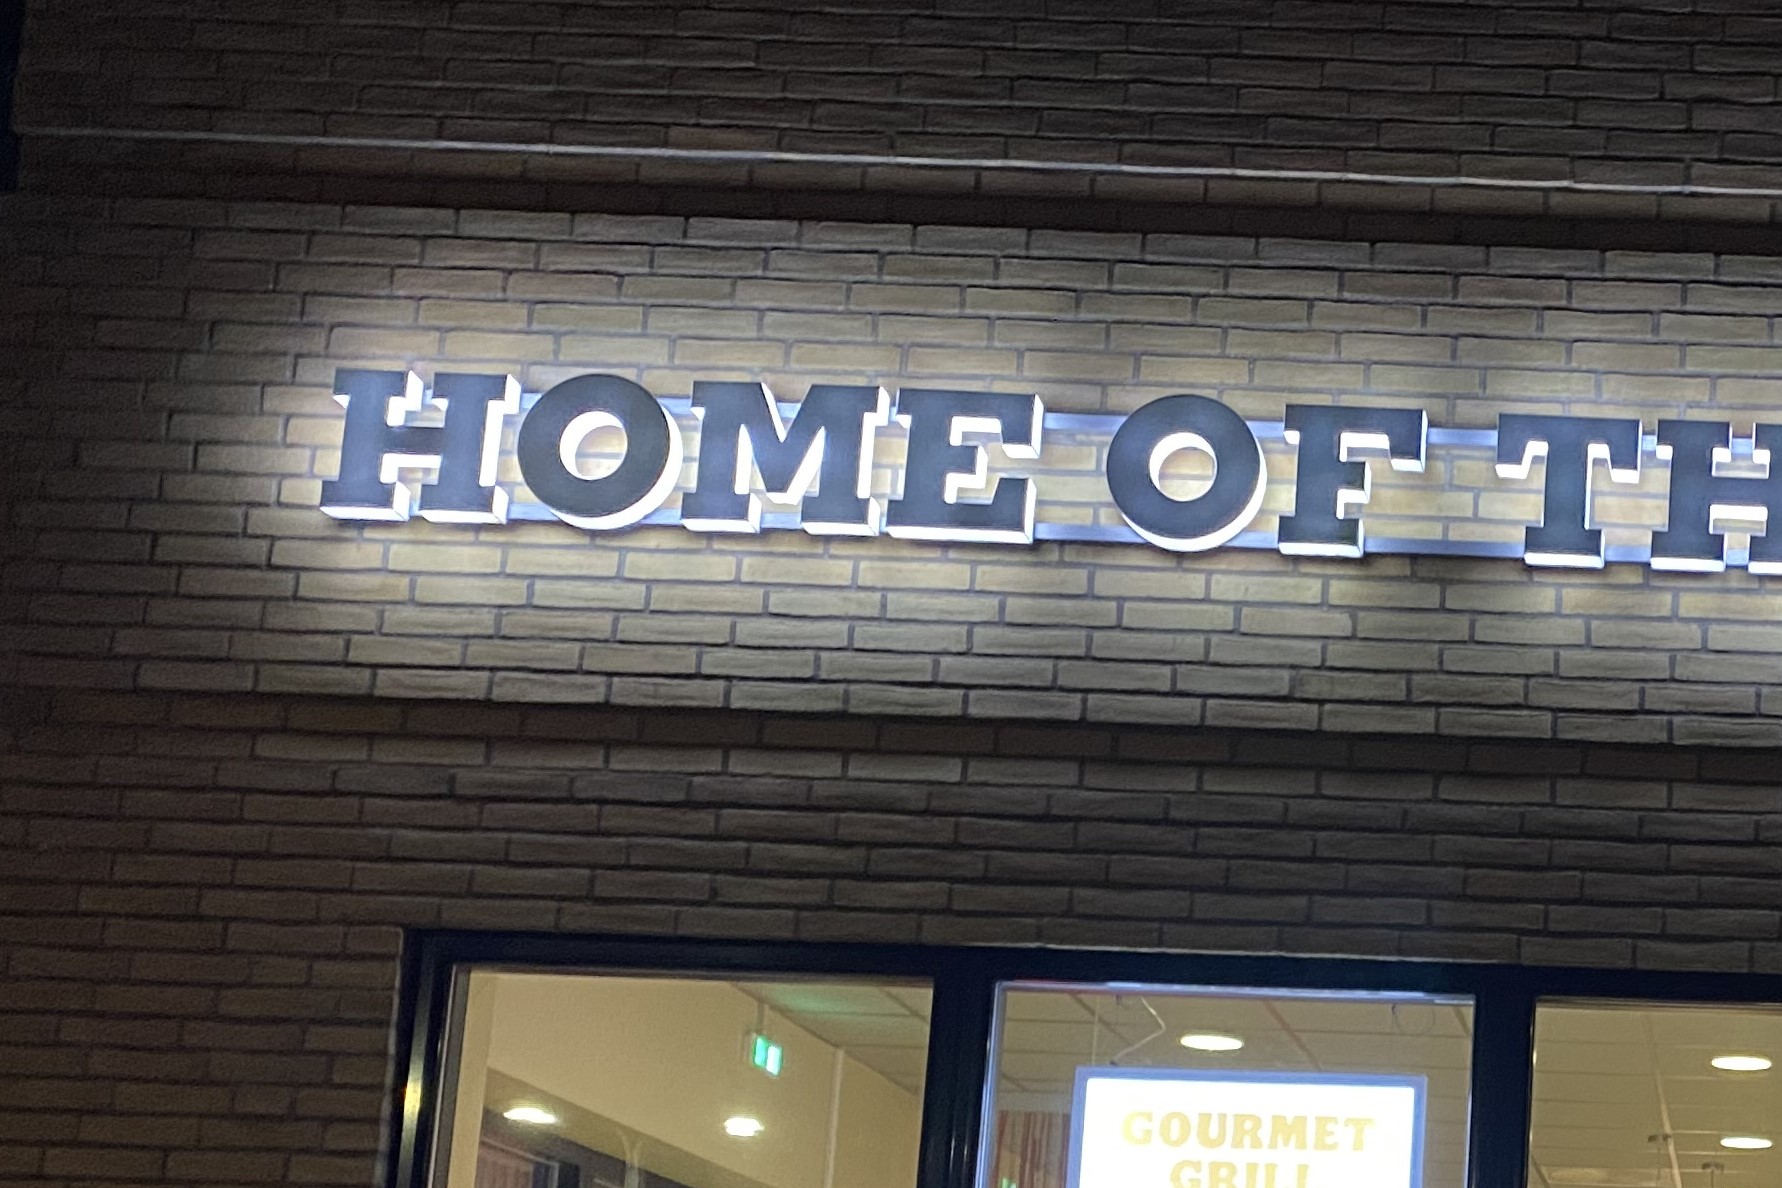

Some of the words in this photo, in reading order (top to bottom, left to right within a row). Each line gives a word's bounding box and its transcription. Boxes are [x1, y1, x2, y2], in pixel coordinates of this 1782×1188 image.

[320, 368, 1043, 544] HOME
[1106, 393, 1428, 558] OF
[1122, 1110, 1377, 1152] GOURMET
